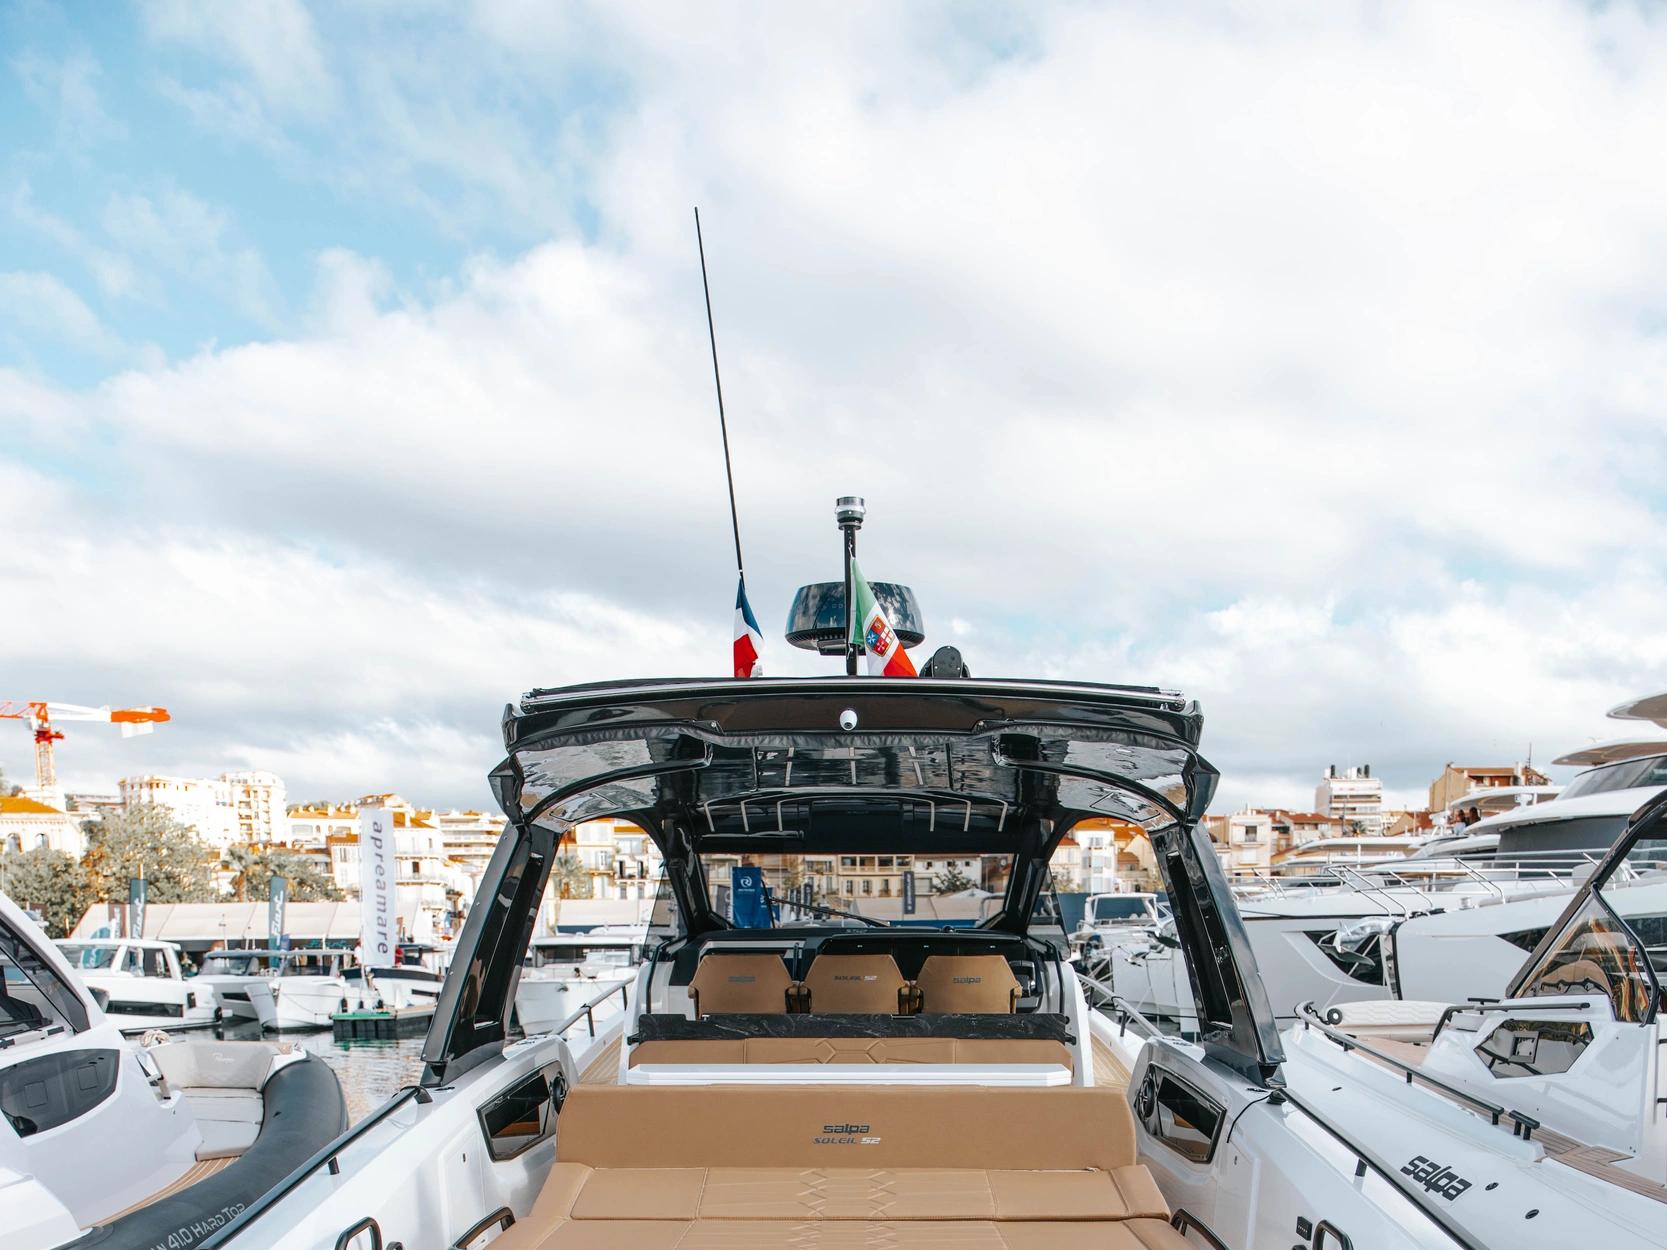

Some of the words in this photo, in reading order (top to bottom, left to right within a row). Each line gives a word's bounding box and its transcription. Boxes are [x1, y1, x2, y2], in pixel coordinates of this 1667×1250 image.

[370, 820, 389, 954] apreamare
[813, 1137, 856, 1145] SOLEIL
[823, 1124, 870, 1135] salpa
[1400, 1155, 1473, 1201] salpa
